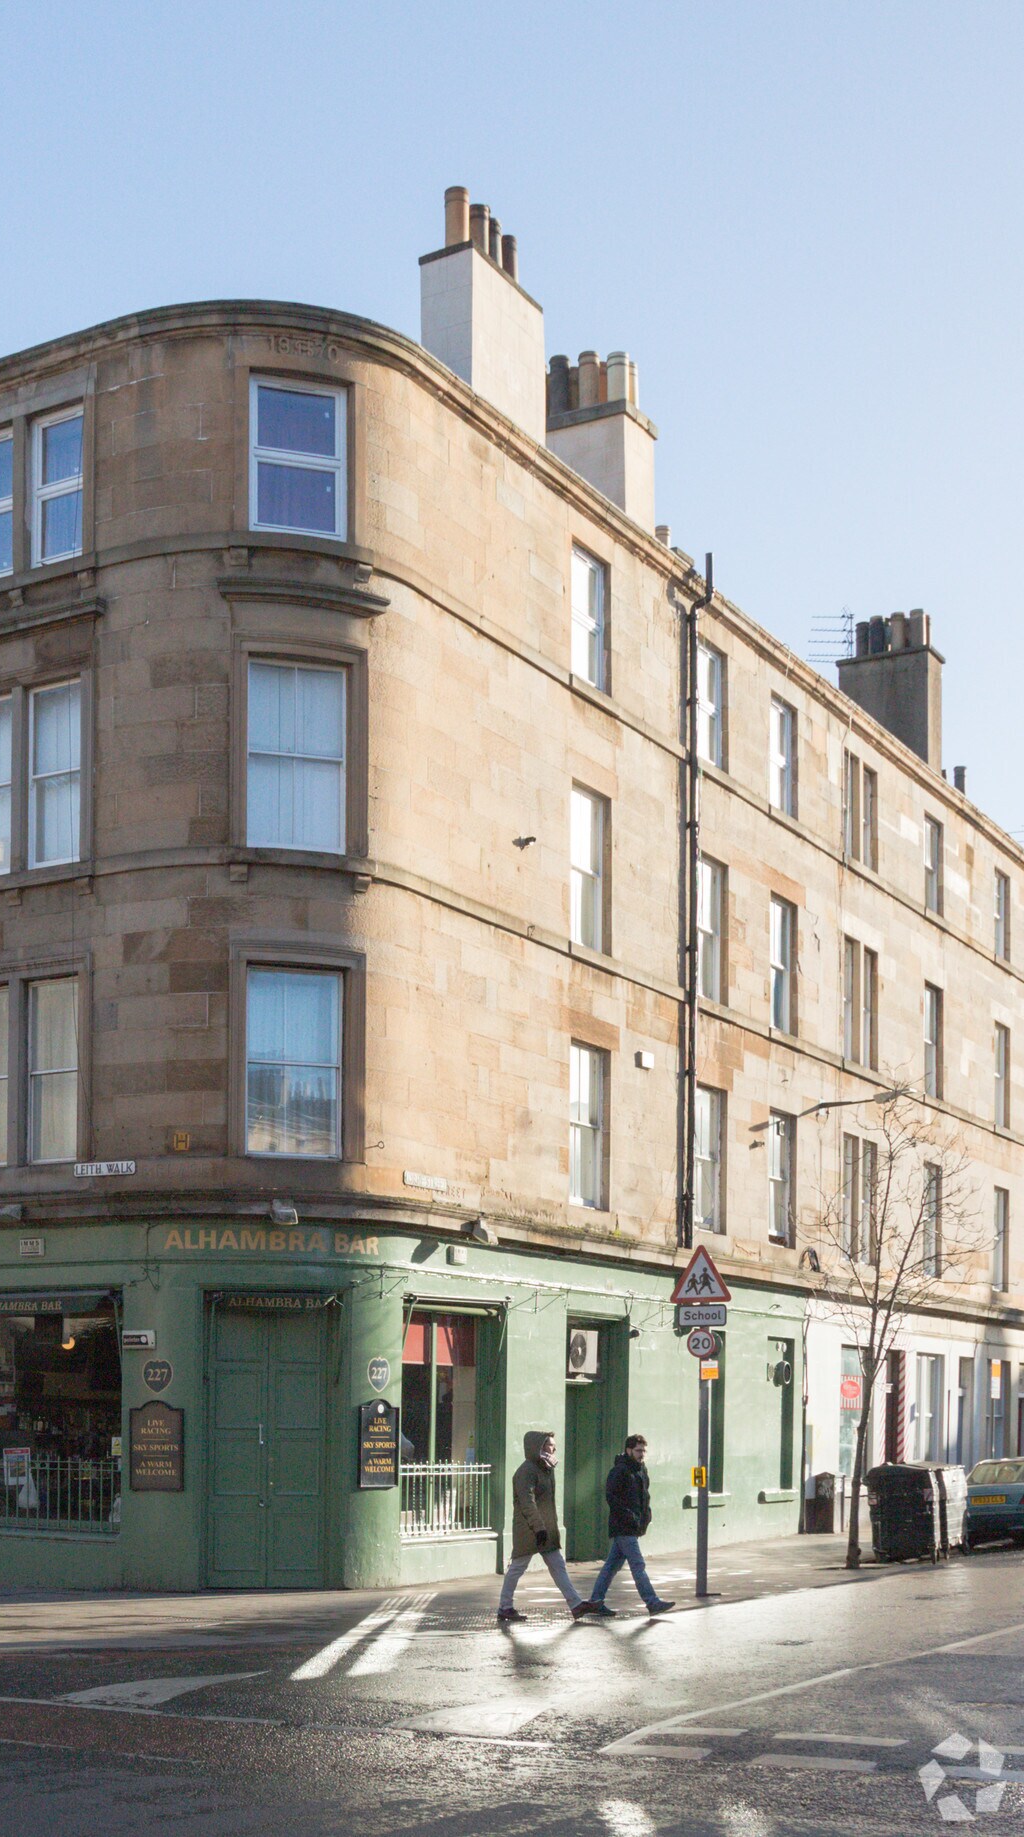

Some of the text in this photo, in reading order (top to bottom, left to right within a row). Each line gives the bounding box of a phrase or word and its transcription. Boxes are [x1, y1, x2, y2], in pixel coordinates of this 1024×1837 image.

[75, 1164, 102, 1176] LEITH
[106, 1162, 134, 1174] WALK
[163, 1229, 380, 1256] ALHAMBRA BAR
[41, 1301, 62, 1311] BAR
[228, 1296, 302, 1308] ALHAMBRA
[683, 1310, 721, 1321] School
[691, 1337, 711, 1350] 20
[146, 1368, 168, 1381] 227
[371, 1367, 388, 1380] 227
[147, 1419, 165, 1427] LIVE
[140, 1427, 172, 1435] RACING
[133, 1443, 179, 1452] SKY SPORTS
[363, 1441, 396, 1449] SKY SPORTS
[147, 1460, 173, 1468] WARM
[373, 1457, 392, 1465] WARM
[135, 1468, 177, 1476] WELCOME
[364, 1465, 395, 1473] WELCOME
